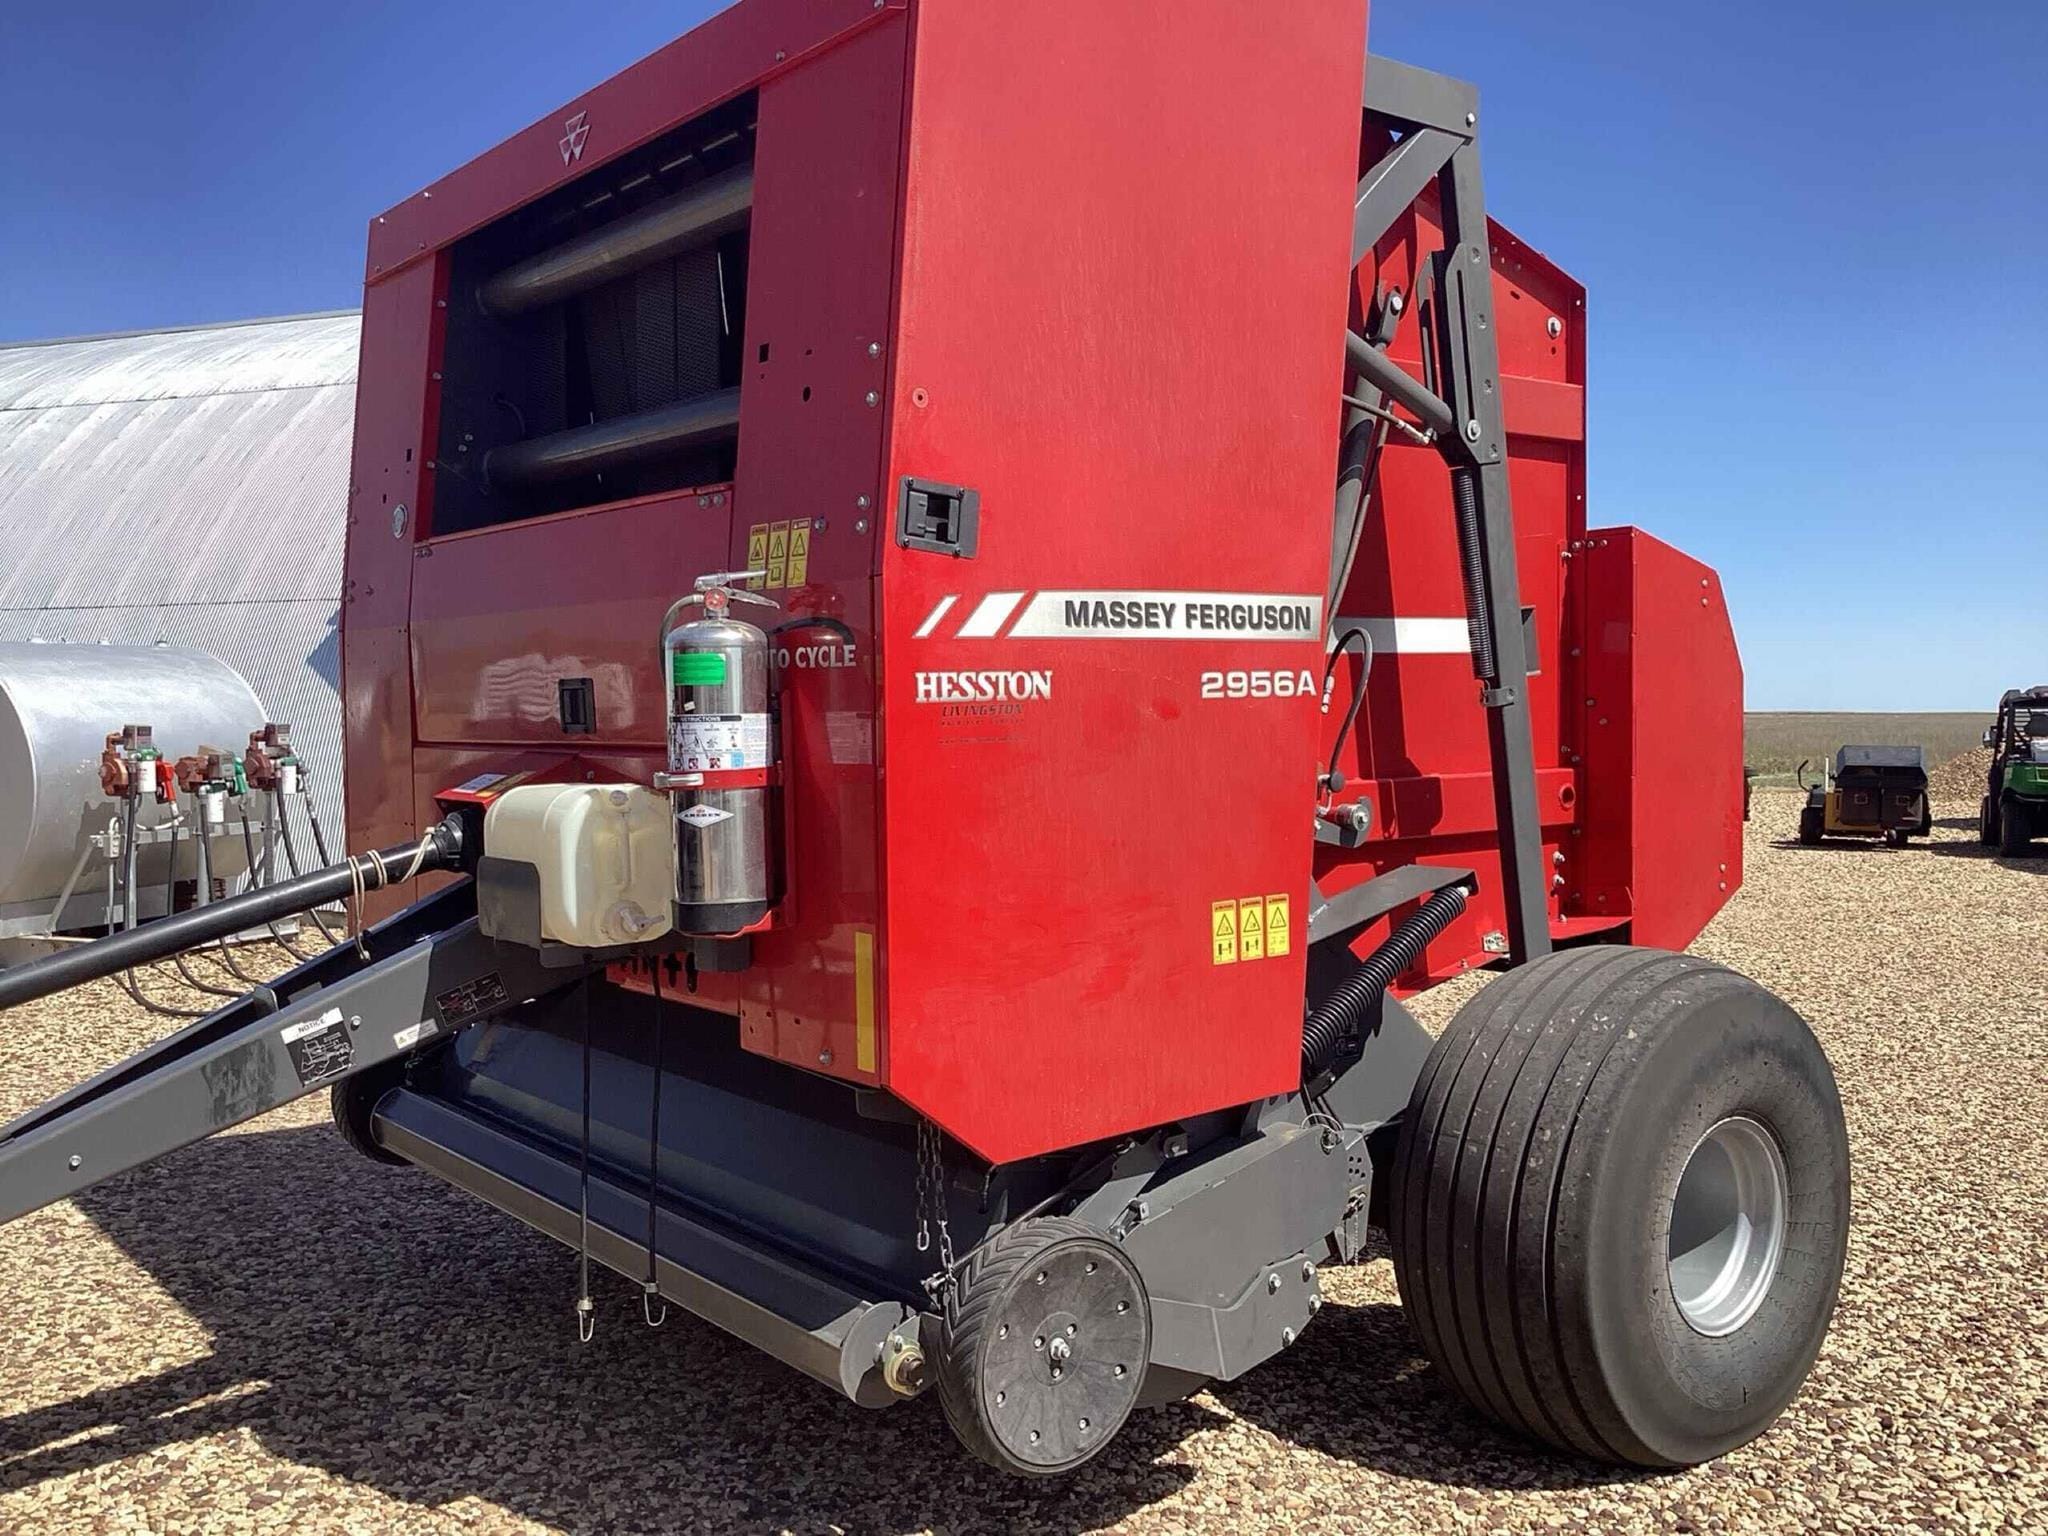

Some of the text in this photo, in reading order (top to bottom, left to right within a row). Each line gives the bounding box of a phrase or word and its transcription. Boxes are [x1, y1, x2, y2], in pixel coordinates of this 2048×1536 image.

[1064, 600, 1312, 632] MASSEY FERGUSON
[795, 644, 857, 669] CYCLE
[914, 669, 1054, 704] HESSTON
[1200, 670, 1318, 699] 2956A
[941, 703, 1024, 717] LIVINGSTON
[297, 1018, 327, 1034] NOTICE
